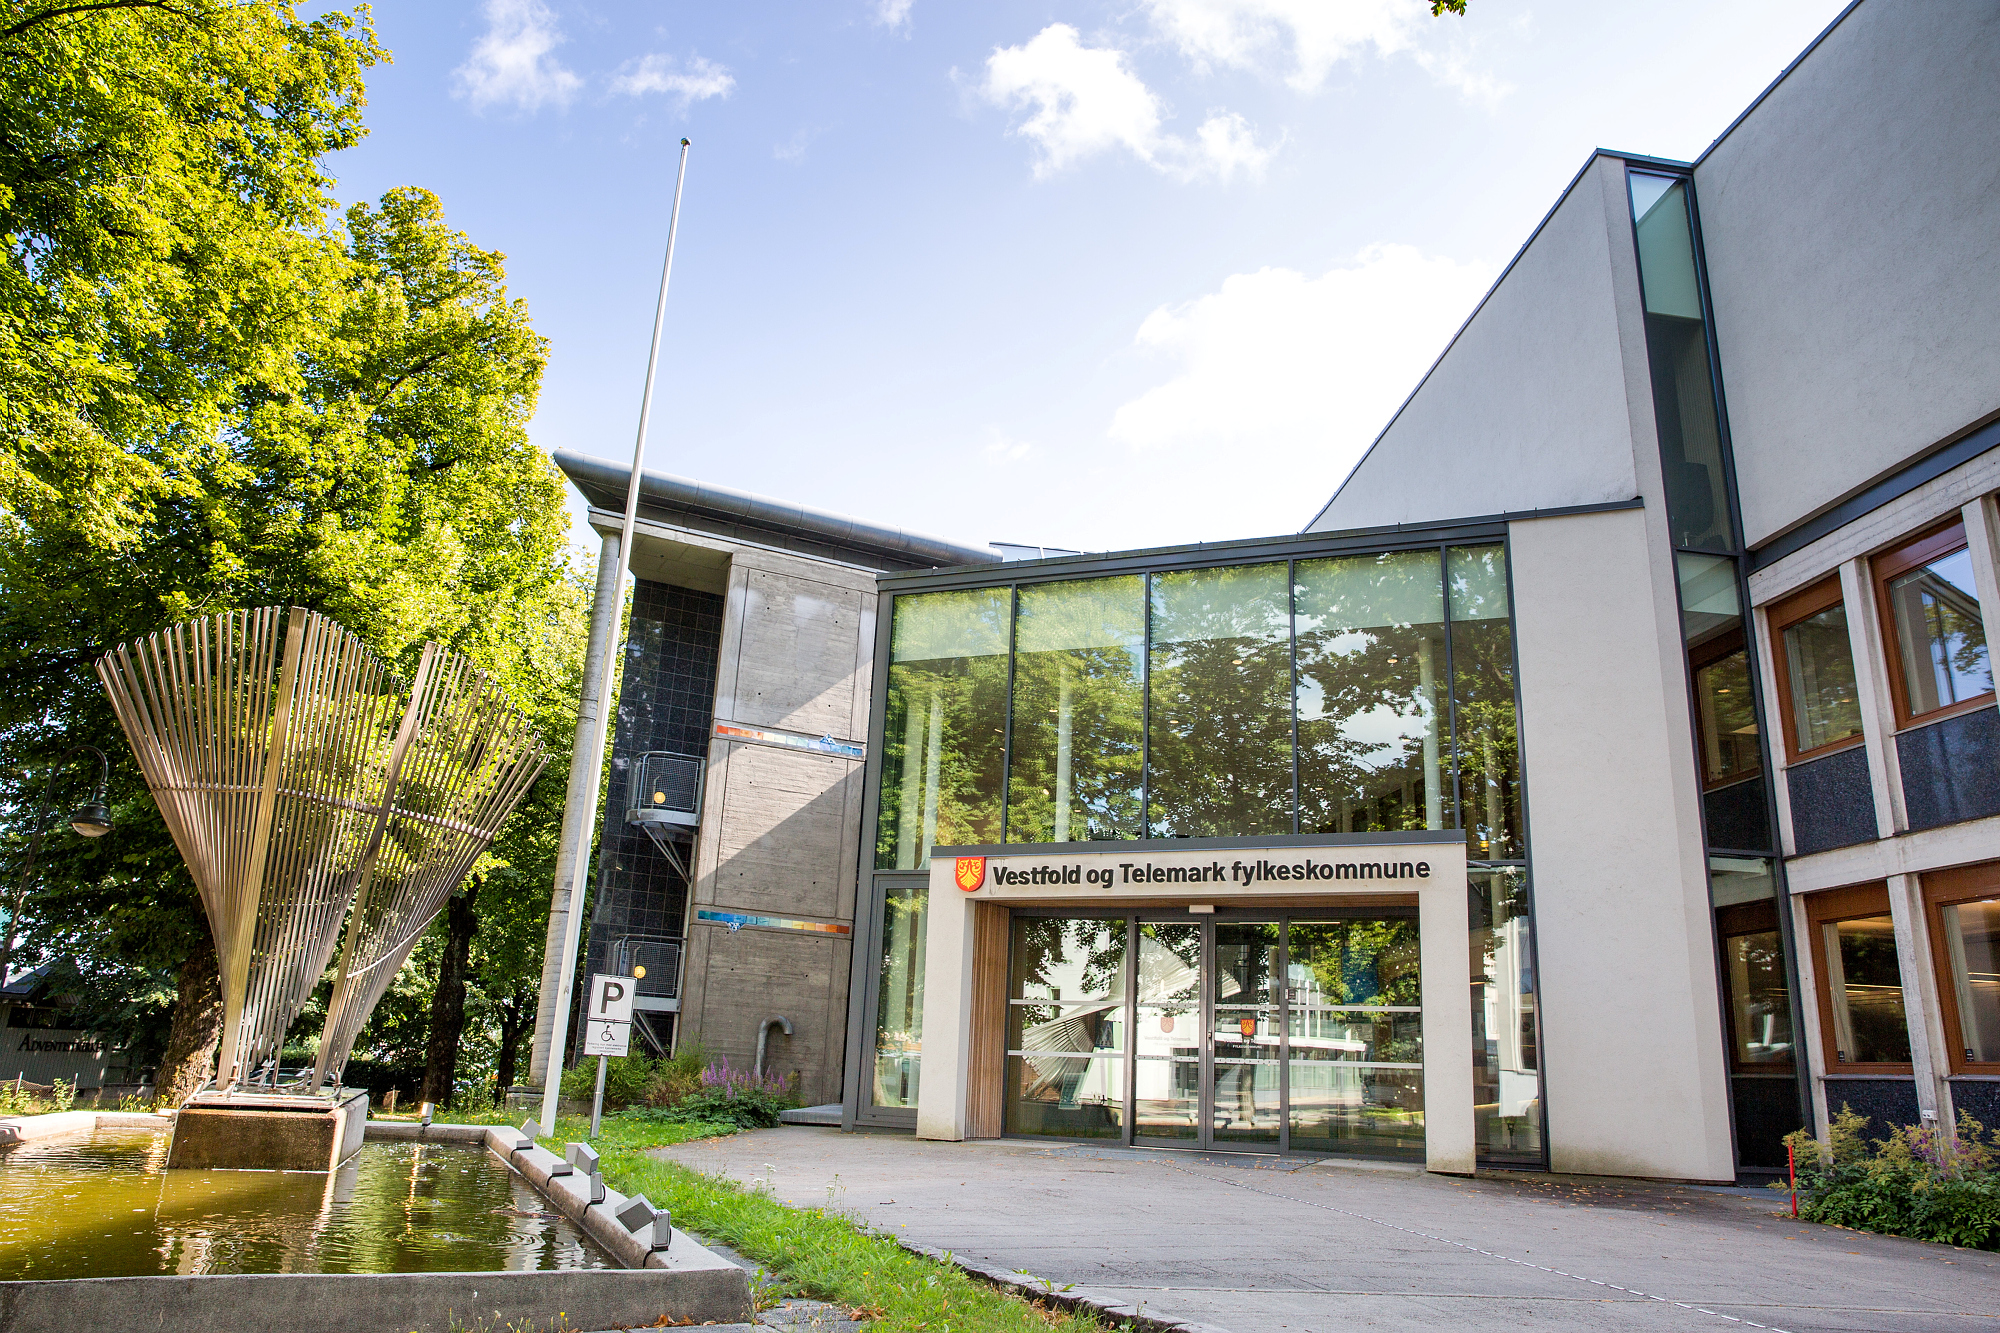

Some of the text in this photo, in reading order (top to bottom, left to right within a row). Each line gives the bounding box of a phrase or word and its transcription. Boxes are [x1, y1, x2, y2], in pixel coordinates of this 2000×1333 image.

[993, 859, 1431, 889] Vestfold og Telemark fylkeskommune
[600, 981, 625, 1014] P
